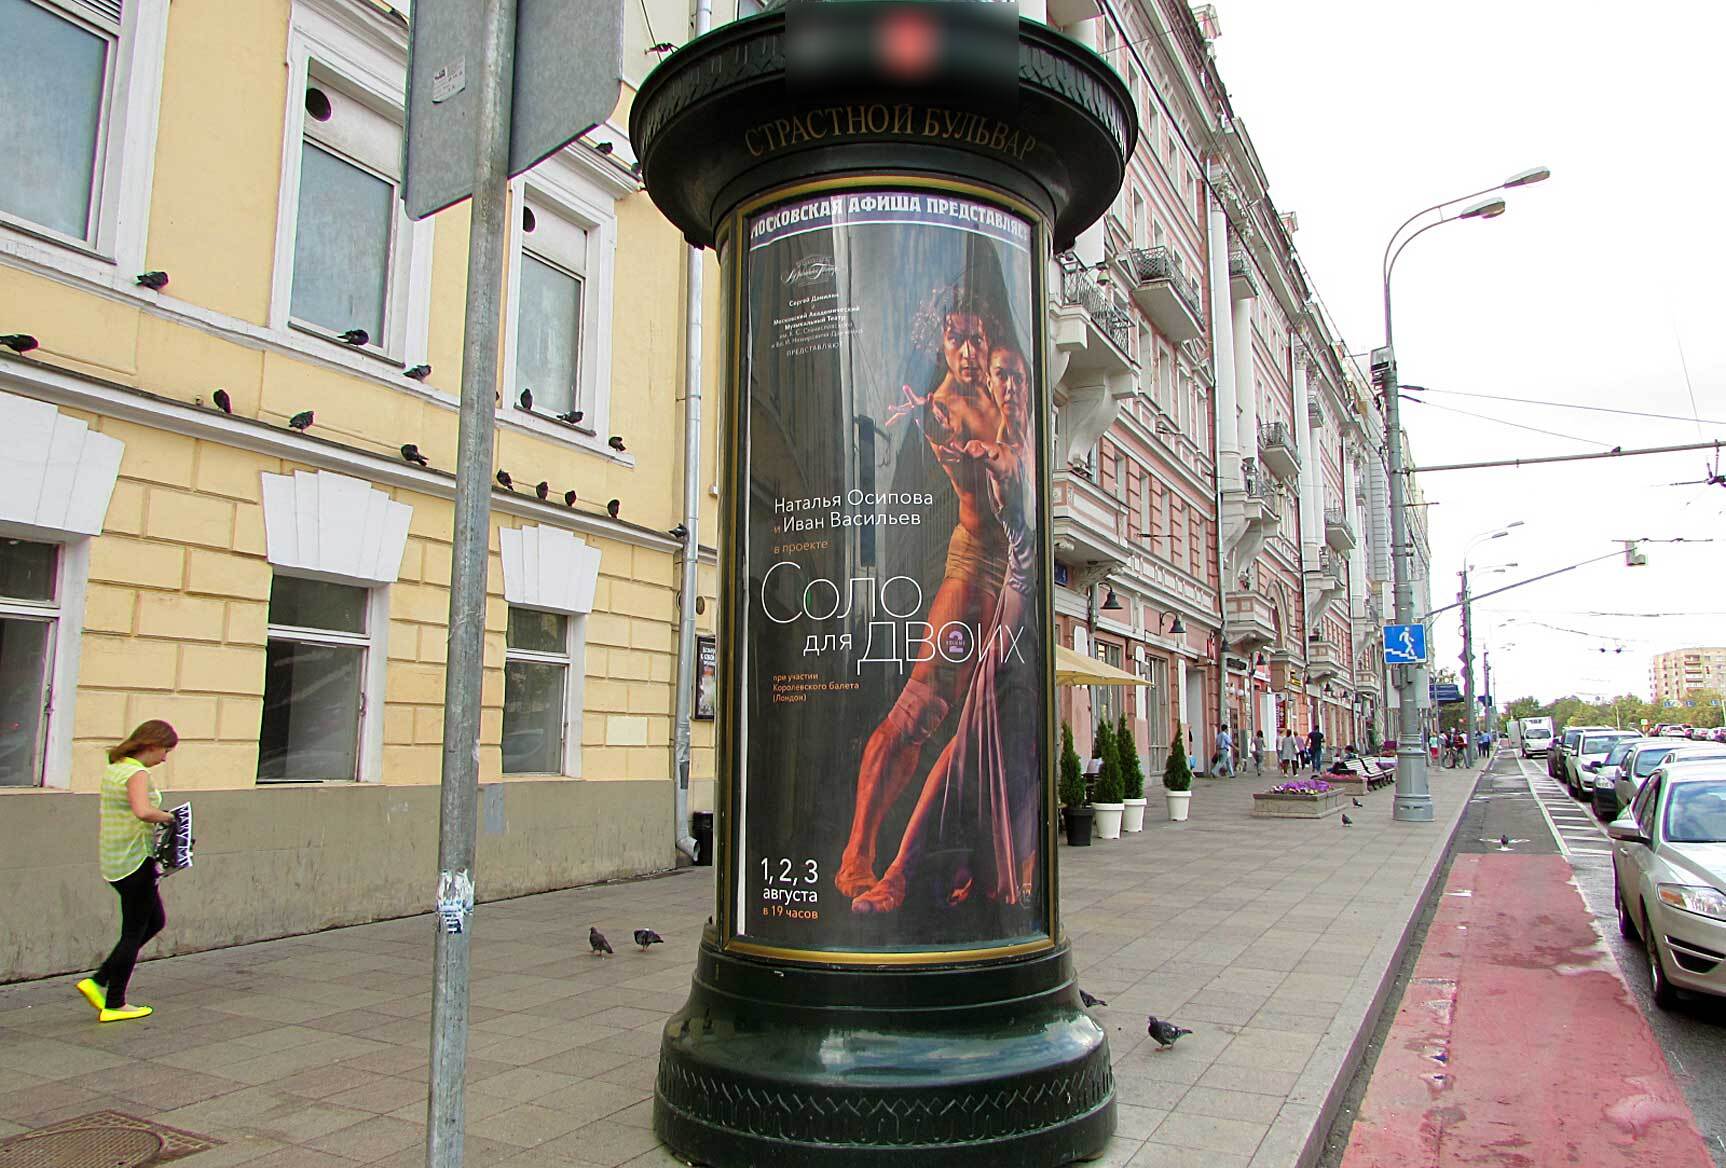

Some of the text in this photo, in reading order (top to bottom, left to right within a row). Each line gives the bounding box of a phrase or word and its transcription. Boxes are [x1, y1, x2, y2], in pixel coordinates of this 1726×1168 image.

[744, 102, 1037, 161] СТРАСТНОЙ БУЛЬВАР
[847, 195, 921, 213] АФИША
[926, 197, 1027, 240] ПРЕДСТАВЛЯЕТ
[788, 298, 810, 307] Сергей
[773, 313, 808, 325] Московский
[786, 341, 840, 356] ПРЕДСТАВЛЯЮ
[774, 489, 933, 514] Наталья Осипова
[773, 512, 921, 534] и Иван Васильев
[773, 539, 828, 554] в проекте
[803, 634, 852, 656] для
[788, 673, 818, 682] участии
[773, 681, 860, 693] Королевского балета
[773, 694, 807, 703] (Лондон)
[761, 857, 819, 886] 1, 2, 3
[763, 887, 818, 906] августа
[763, 905, 819, 919] в 19 часов
